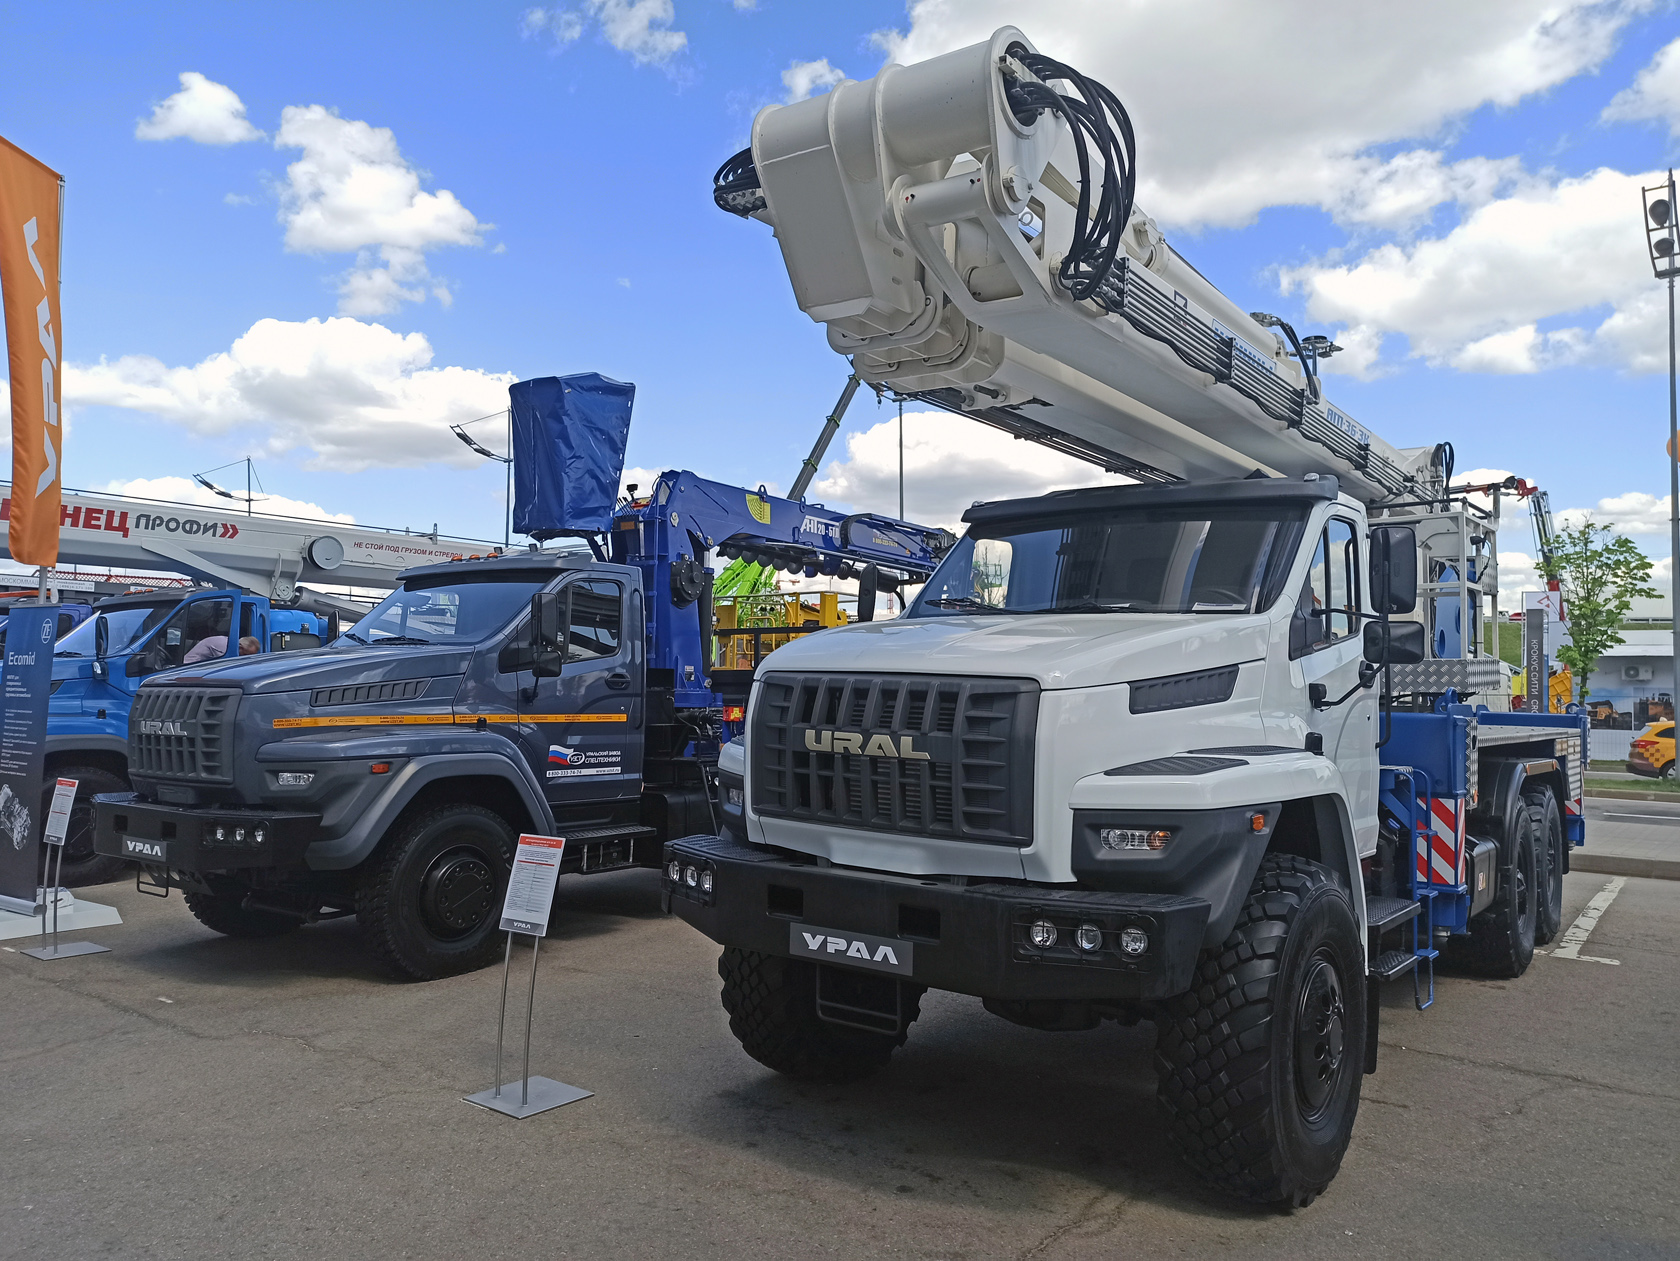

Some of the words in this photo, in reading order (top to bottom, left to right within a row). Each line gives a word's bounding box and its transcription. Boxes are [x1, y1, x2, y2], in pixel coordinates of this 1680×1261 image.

[23, 216, 58, 499] УРАЛ
[135, 513, 219, 538] ПРОФИ
[365, 542, 384, 550] СТОЙ
[385, 545, 400, 553] ПОД
[401, 546, 427, 556] ГРУЗОМ
[8, 651, 36, 666] Ecomid
[1531, 639, 1539, 671] КРОКУС
[1531, 672, 1539, 695] СИТИ
[140, 720, 188, 736] URAL
[804, 729, 931, 760] URAL
[126, 840, 162, 857] УРАЛ
[513, 921, 531, 930] УРАЛ
[802, 931, 899, 965] УРАЛ
